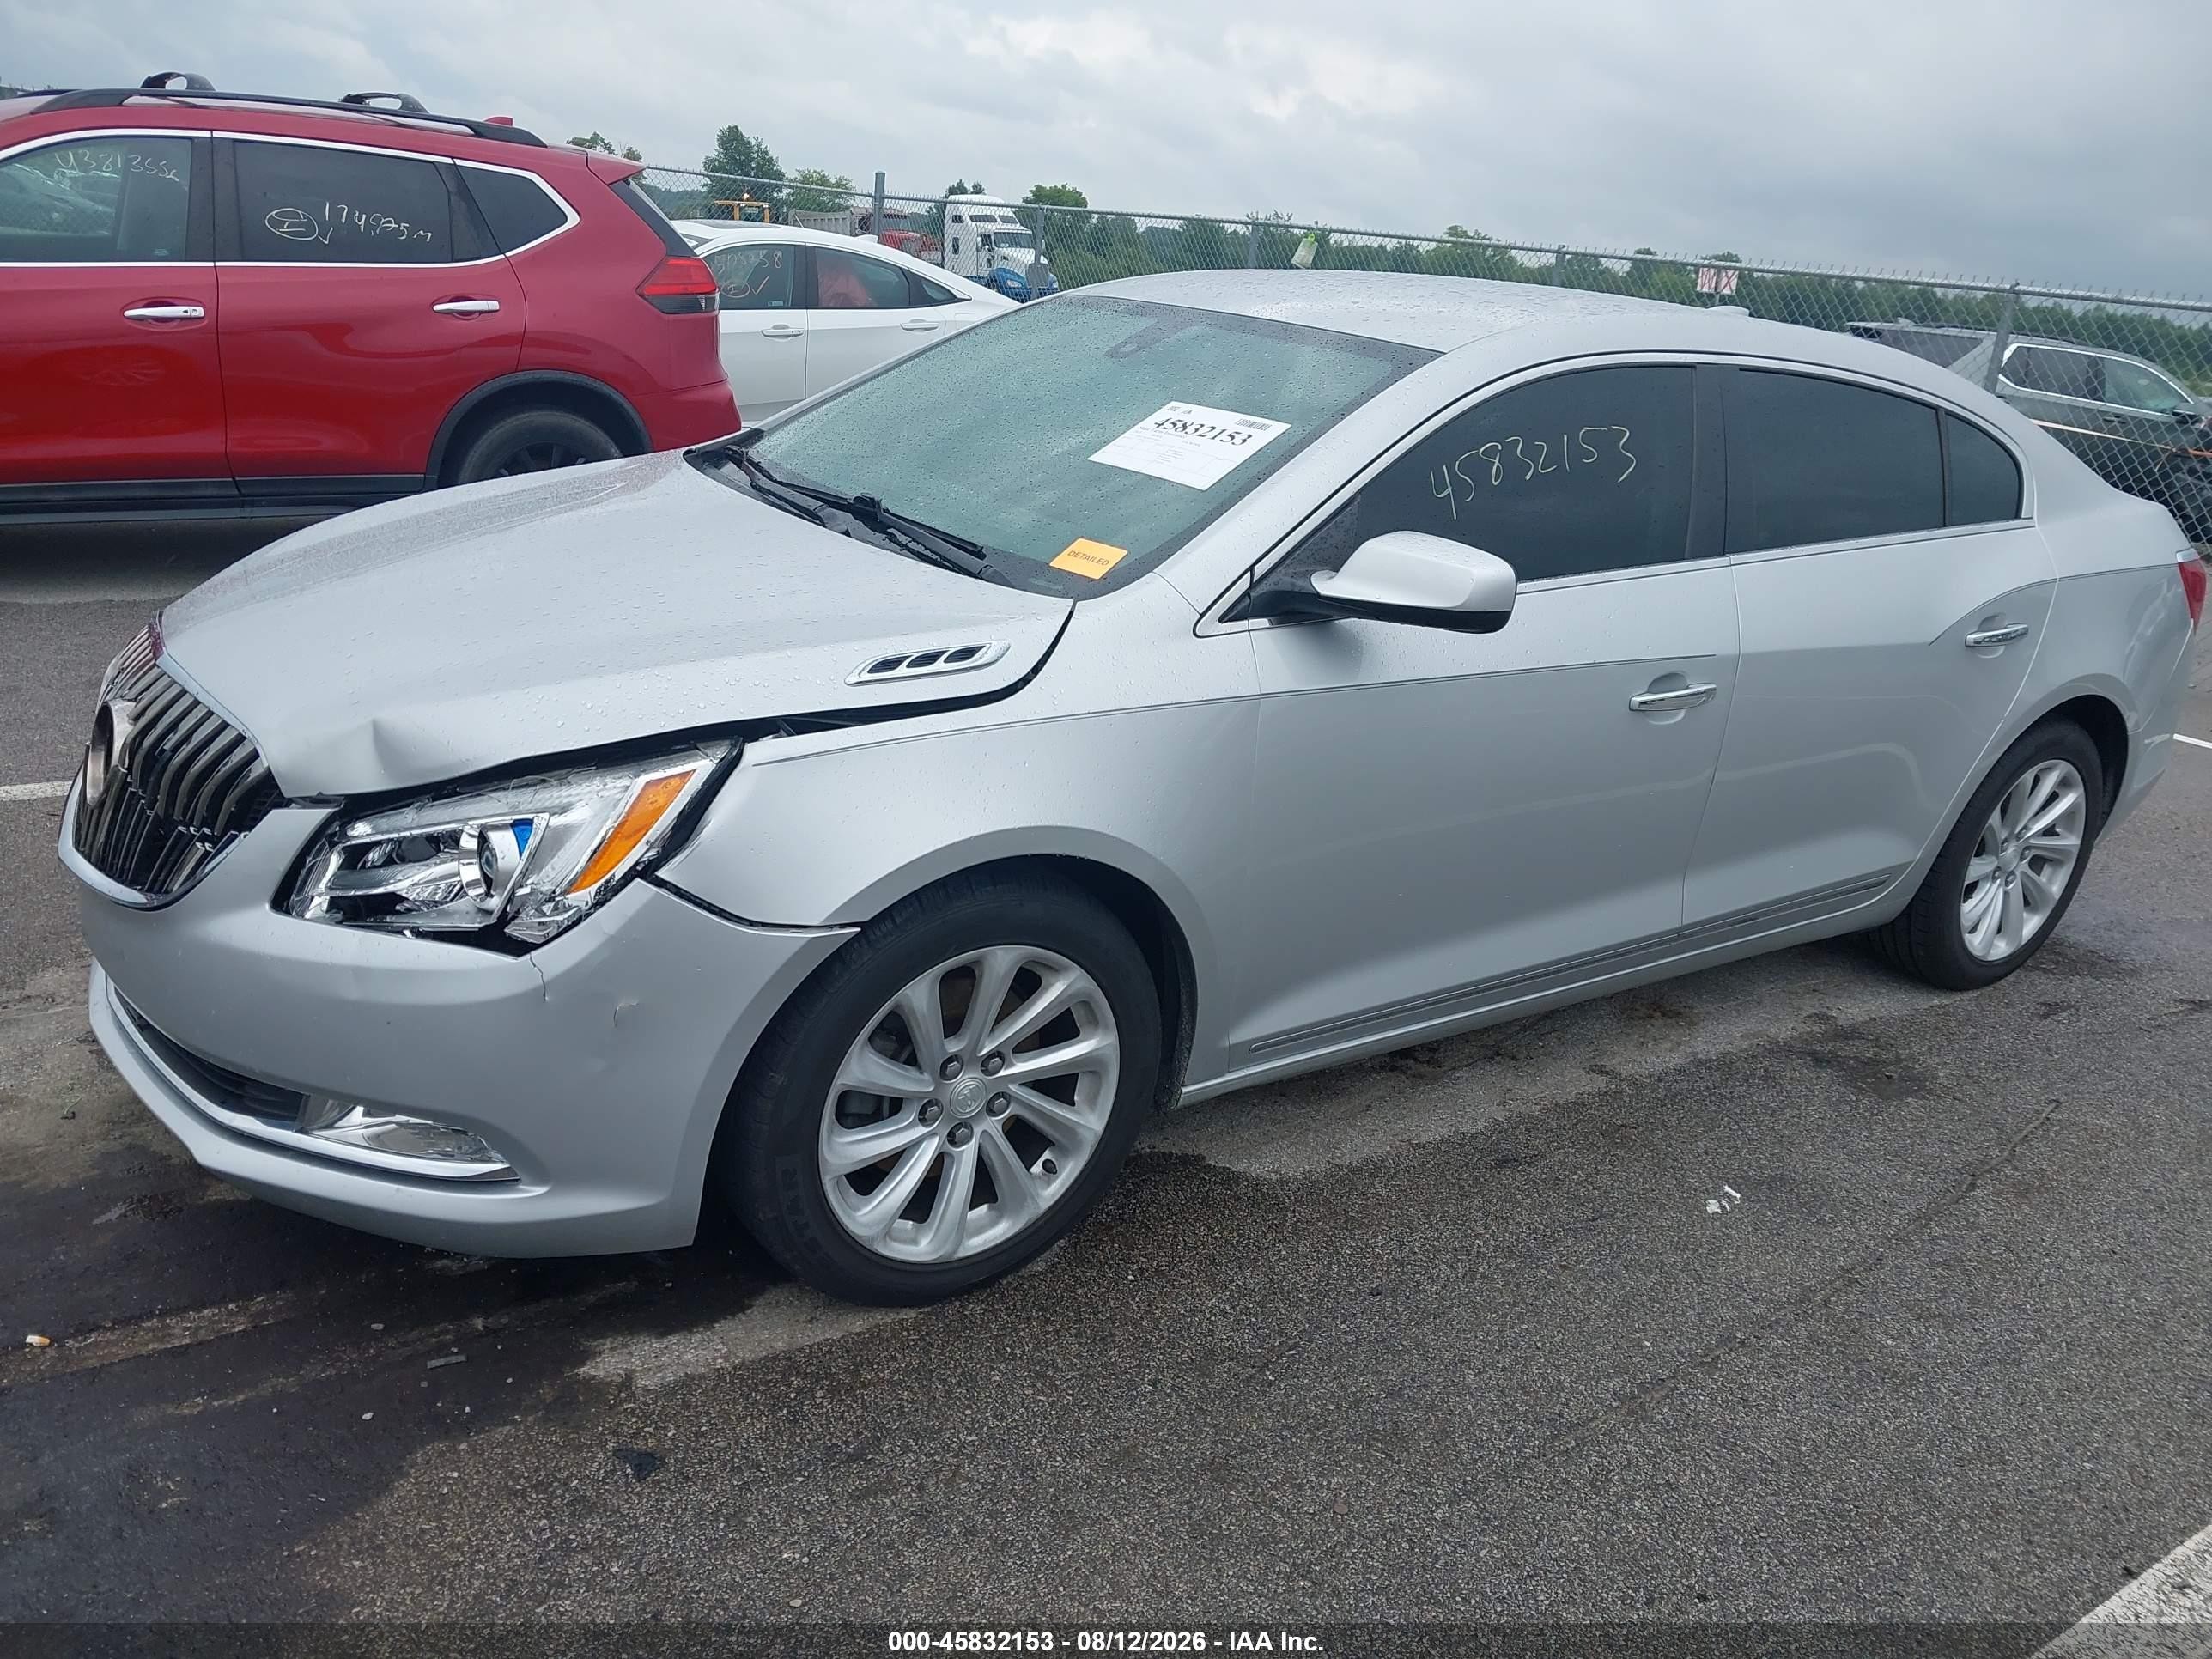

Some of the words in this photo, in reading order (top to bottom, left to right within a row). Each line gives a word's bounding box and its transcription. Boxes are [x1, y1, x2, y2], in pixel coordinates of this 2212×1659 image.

[1153, 417, 1253, 446] 45832153
[1430, 425, 1637, 520] 45832153
[1066, 550, 1110, 566] DETAILED
